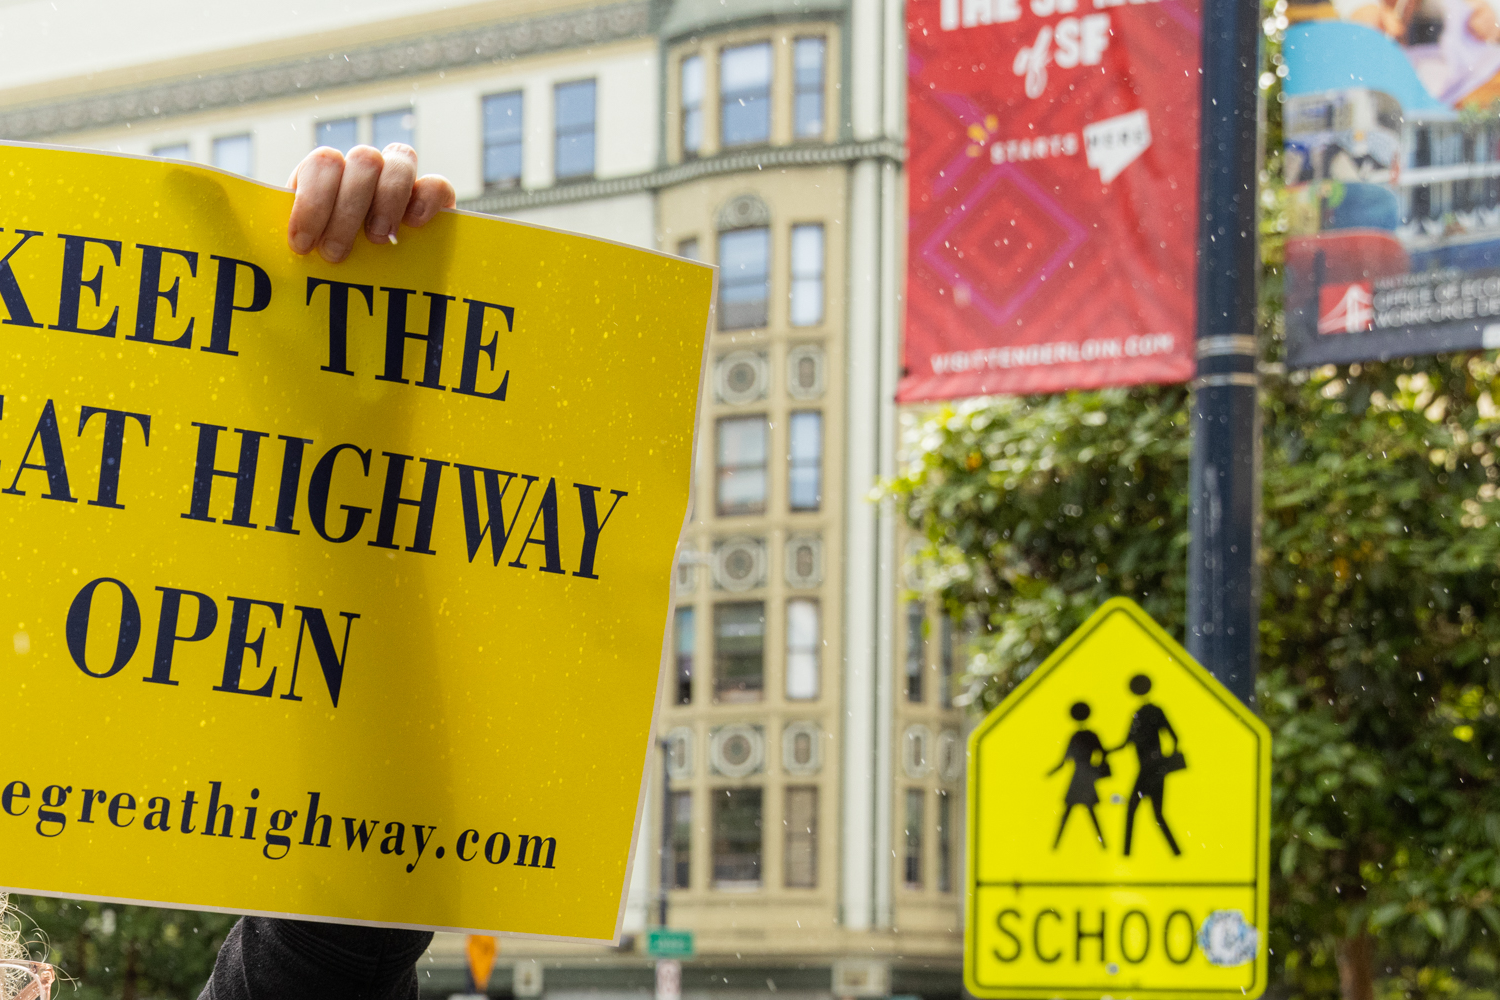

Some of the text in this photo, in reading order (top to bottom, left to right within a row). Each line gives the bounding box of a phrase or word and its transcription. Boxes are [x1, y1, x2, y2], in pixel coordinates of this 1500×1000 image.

[1013, 12, 1112, 99] of SF
[990, 132, 1079, 165] STARTS
[305, 275, 515, 402] THE
[930, 333, 1175, 375] VISITTENDERLOIN.COM
[180, 421, 629, 581] HIGHWAY
[65, 577, 362, 709] OPEN
[992, 908, 1215, 965] SCHOO
